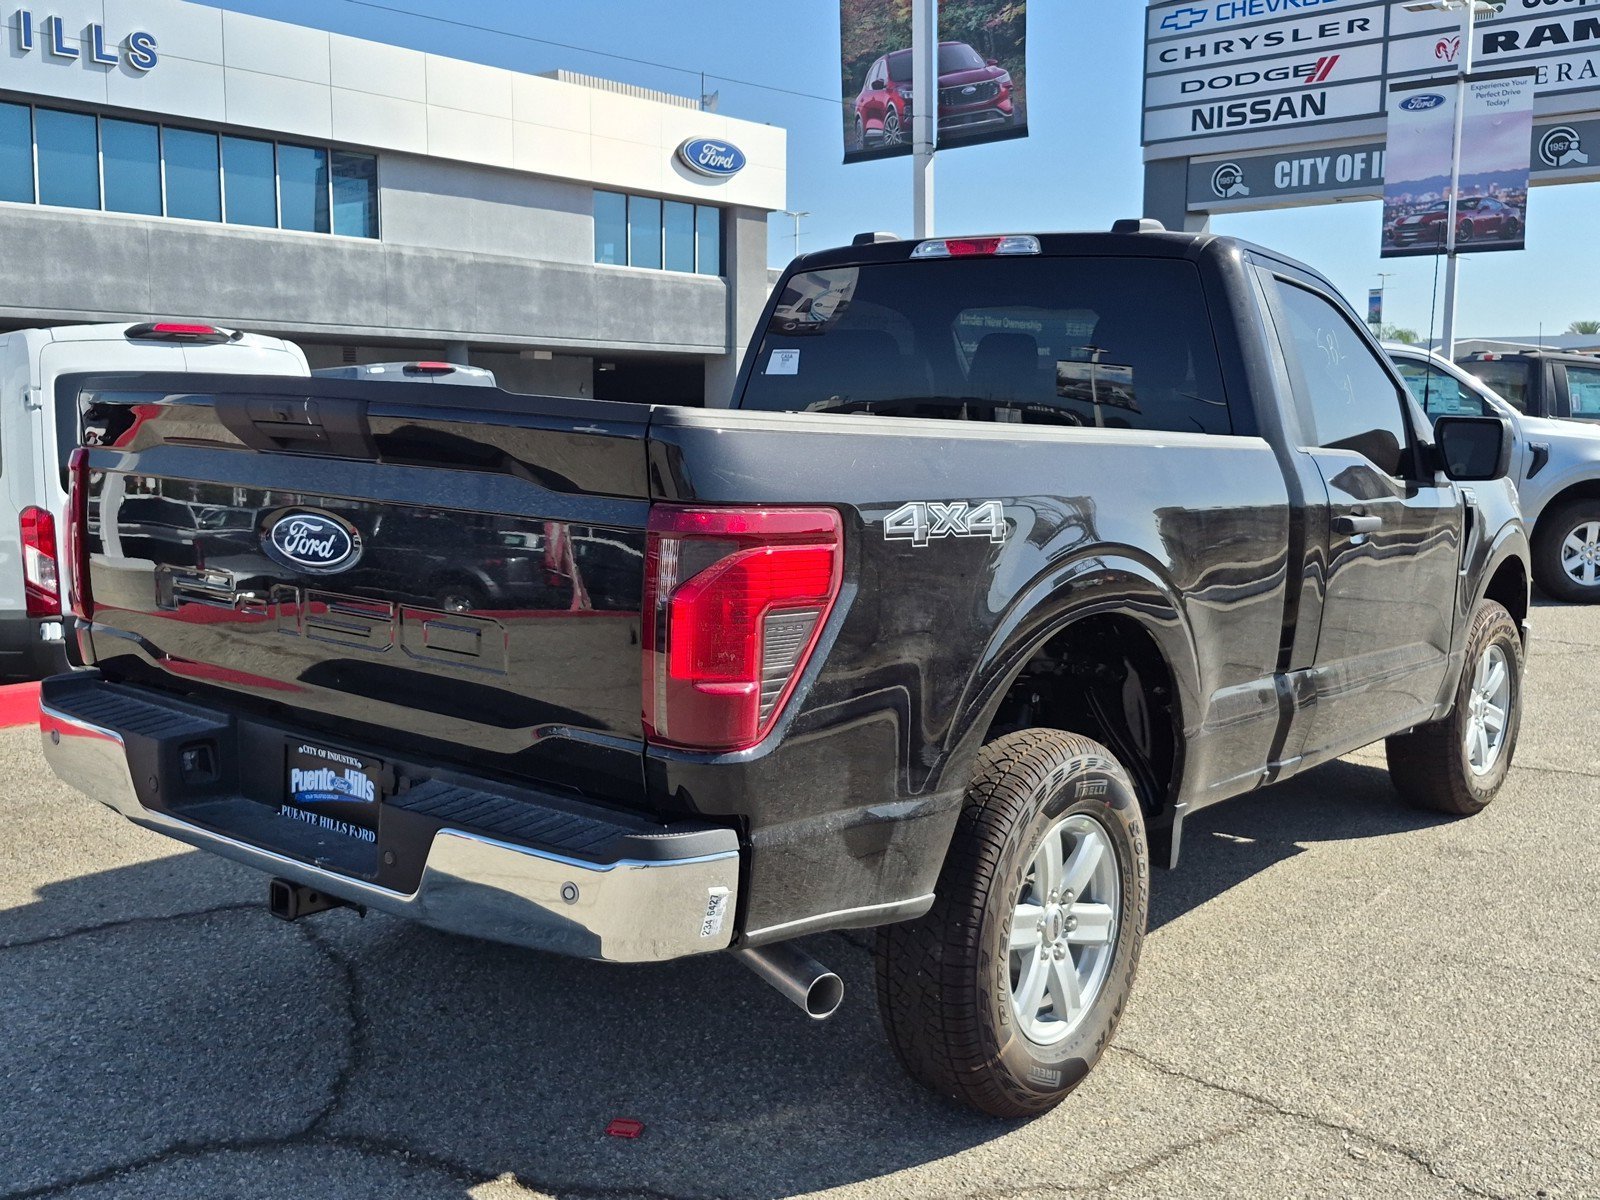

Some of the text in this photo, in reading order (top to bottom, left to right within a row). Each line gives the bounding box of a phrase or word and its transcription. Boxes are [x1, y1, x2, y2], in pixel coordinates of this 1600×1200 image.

[1159, 17, 1371, 63] CHRYSLER
[1181, 62, 1318, 94] DODGE
[1471, 81, 1510, 91] Experience
[1407, 95, 1437, 110] Ford
[1476, 91, 1500, 99] Perfect
[1486, 99, 1509, 107] Today!
[1191, 92, 1327, 132] NISSAN
[698, 143, 735, 170] Ford
[1549, 141, 1569, 151] 1957
[1274, 150, 1387, 189] CITY OF I
[284, 520, 336, 559] Ford
[302, 744, 359, 767] CITY OF INDUSTRY
[291, 767, 375, 802] Puente Hills
[1074, 779, 1108, 799] PIRELLI
[281, 804, 376, 843] PUENTE HILLS FORD
[702, 920, 712, 936] 234
[707, 895, 719, 916] 6427
